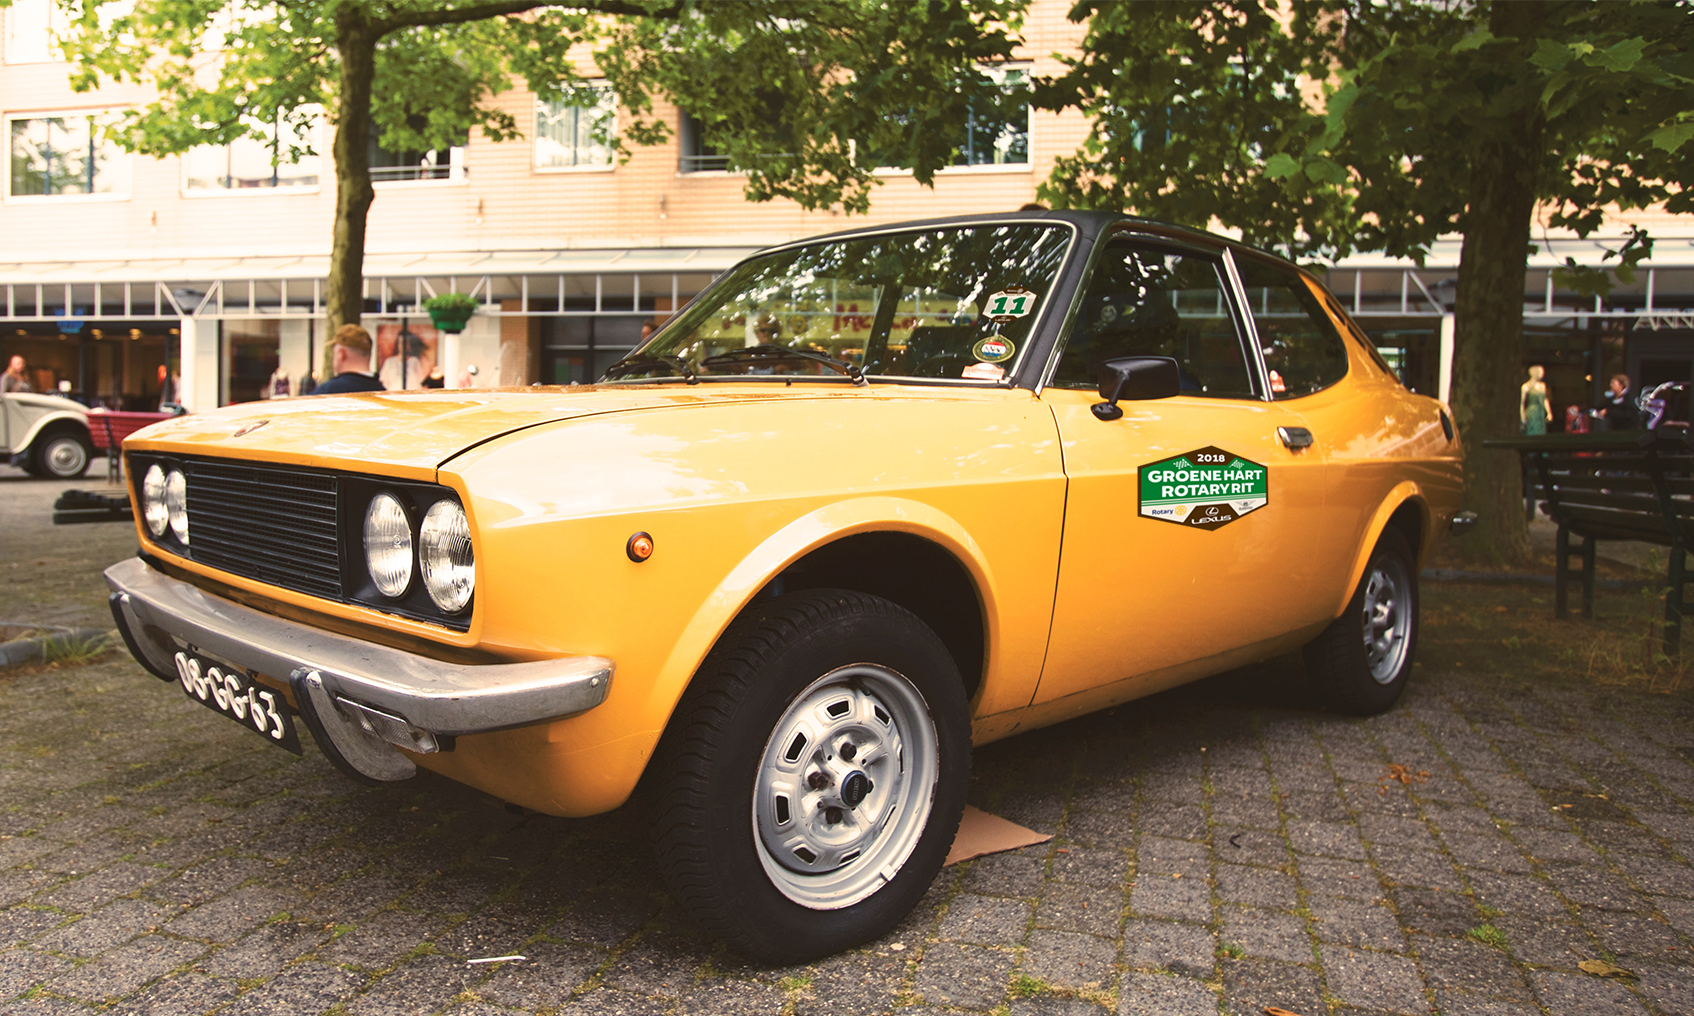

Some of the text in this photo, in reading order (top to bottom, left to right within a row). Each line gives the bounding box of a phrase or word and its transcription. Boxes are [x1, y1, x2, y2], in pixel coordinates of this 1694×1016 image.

[990, 296, 1027, 315] 11
[1197, 454, 1225, 463] 2018
[1147, 469, 1263, 483] GROENE HART
[1161, 482, 1255, 498] ROTARY RIT
[1191, 514, 1232, 525] LEXUS
[175, 651, 285, 740] 08-GG-63
